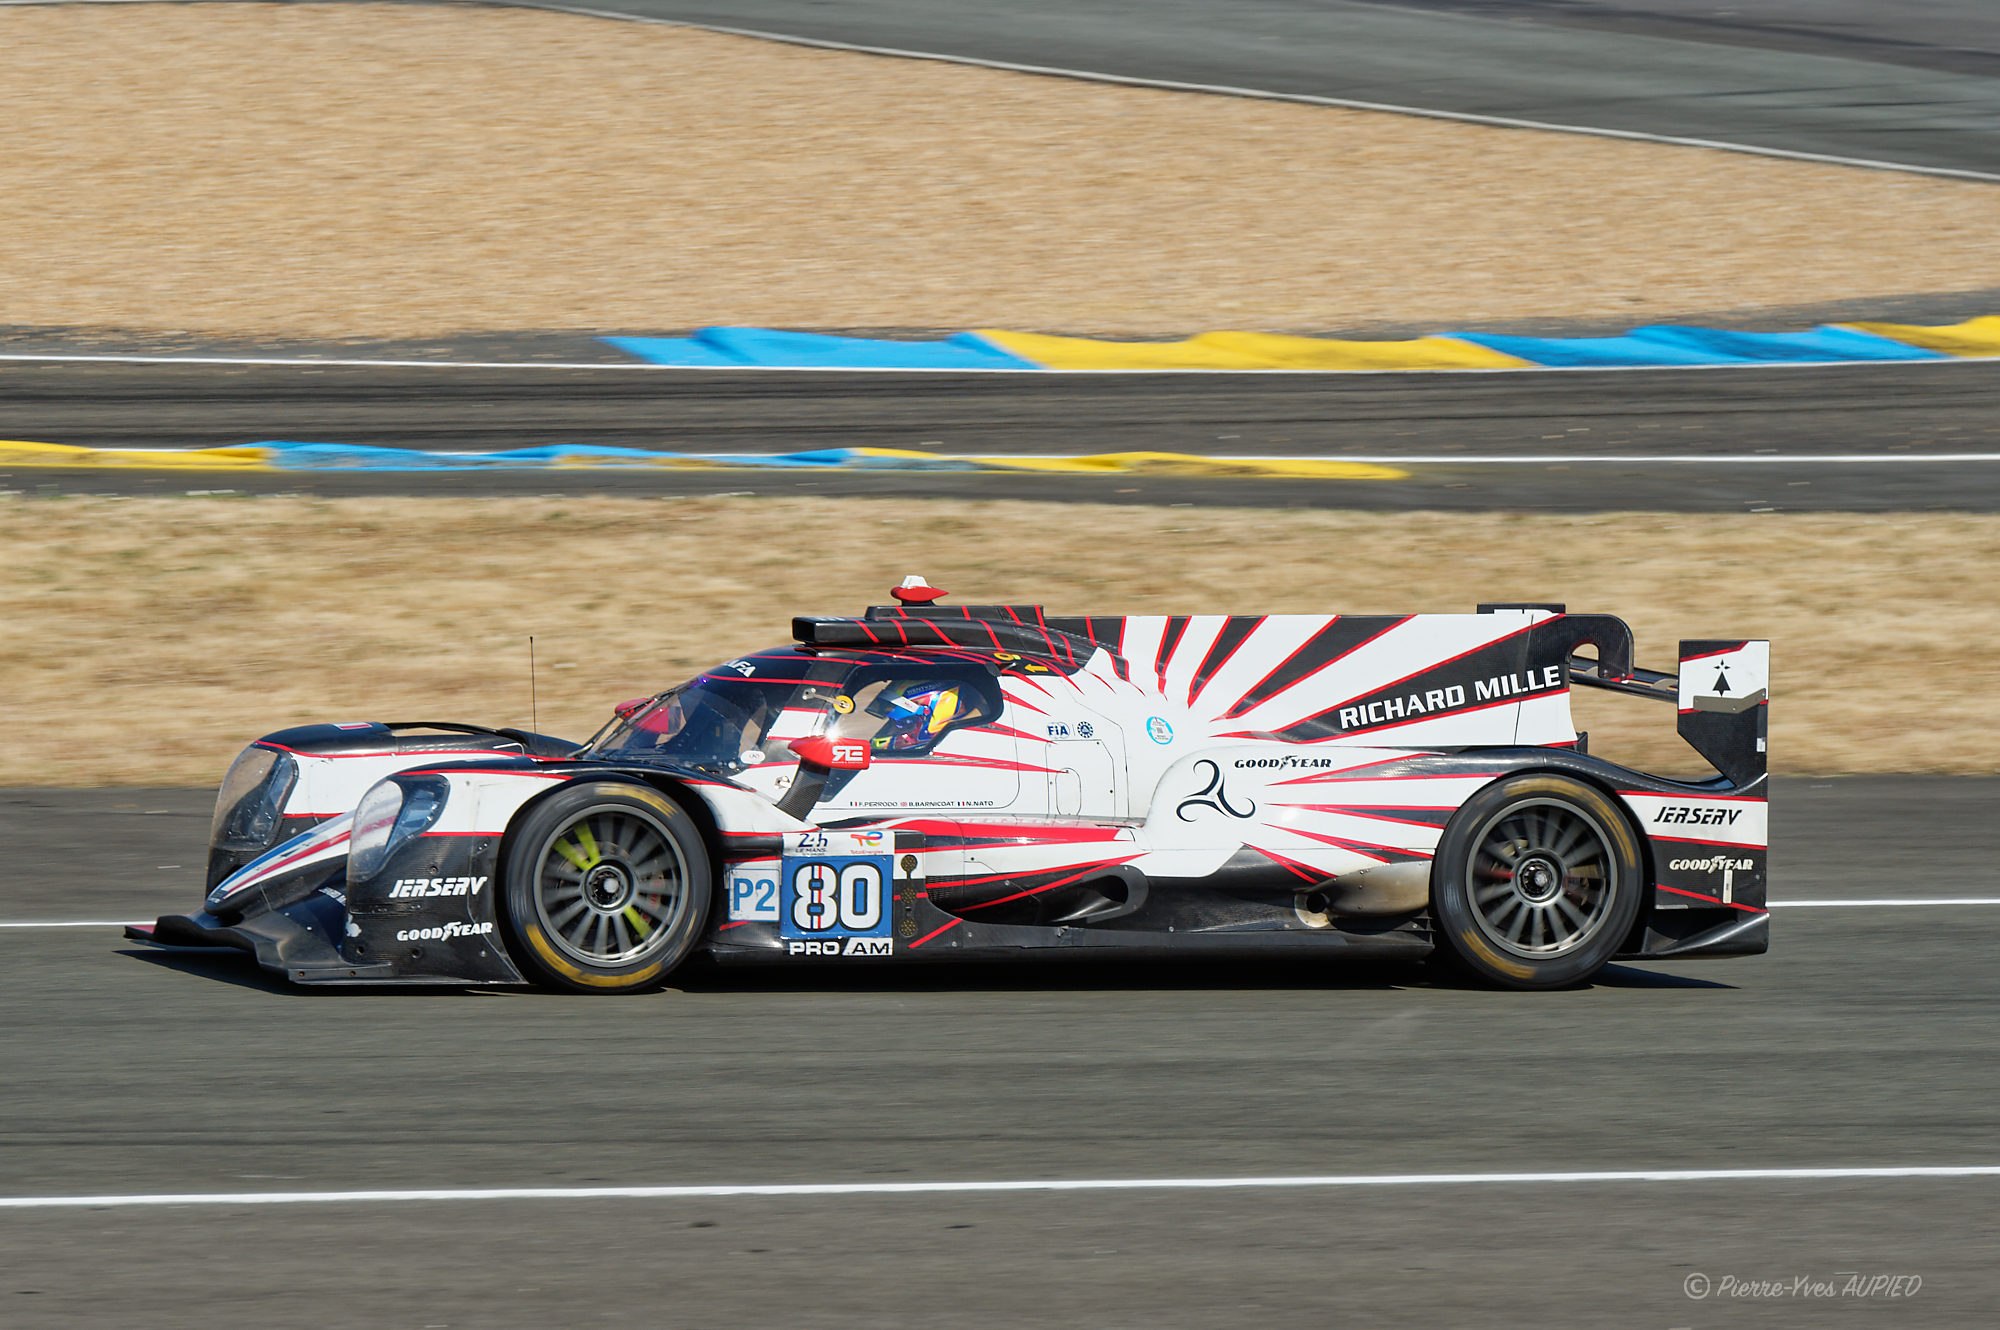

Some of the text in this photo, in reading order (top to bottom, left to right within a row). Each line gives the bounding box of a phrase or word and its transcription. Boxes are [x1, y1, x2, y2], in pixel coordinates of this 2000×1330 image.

[1339, 665, 1562, 729] RICHARD MILLE
[1234, 755, 1332, 770] GOODYEAR
[1653, 806, 1743, 825] JERSERV
[388, 876, 488, 898] JERSERV
[733, 878, 776, 912] P2
[791, 862, 883, 932] 80
[396, 921, 494, 942] GOODYEAR
[789, 941, 890, 956] PRO AM
